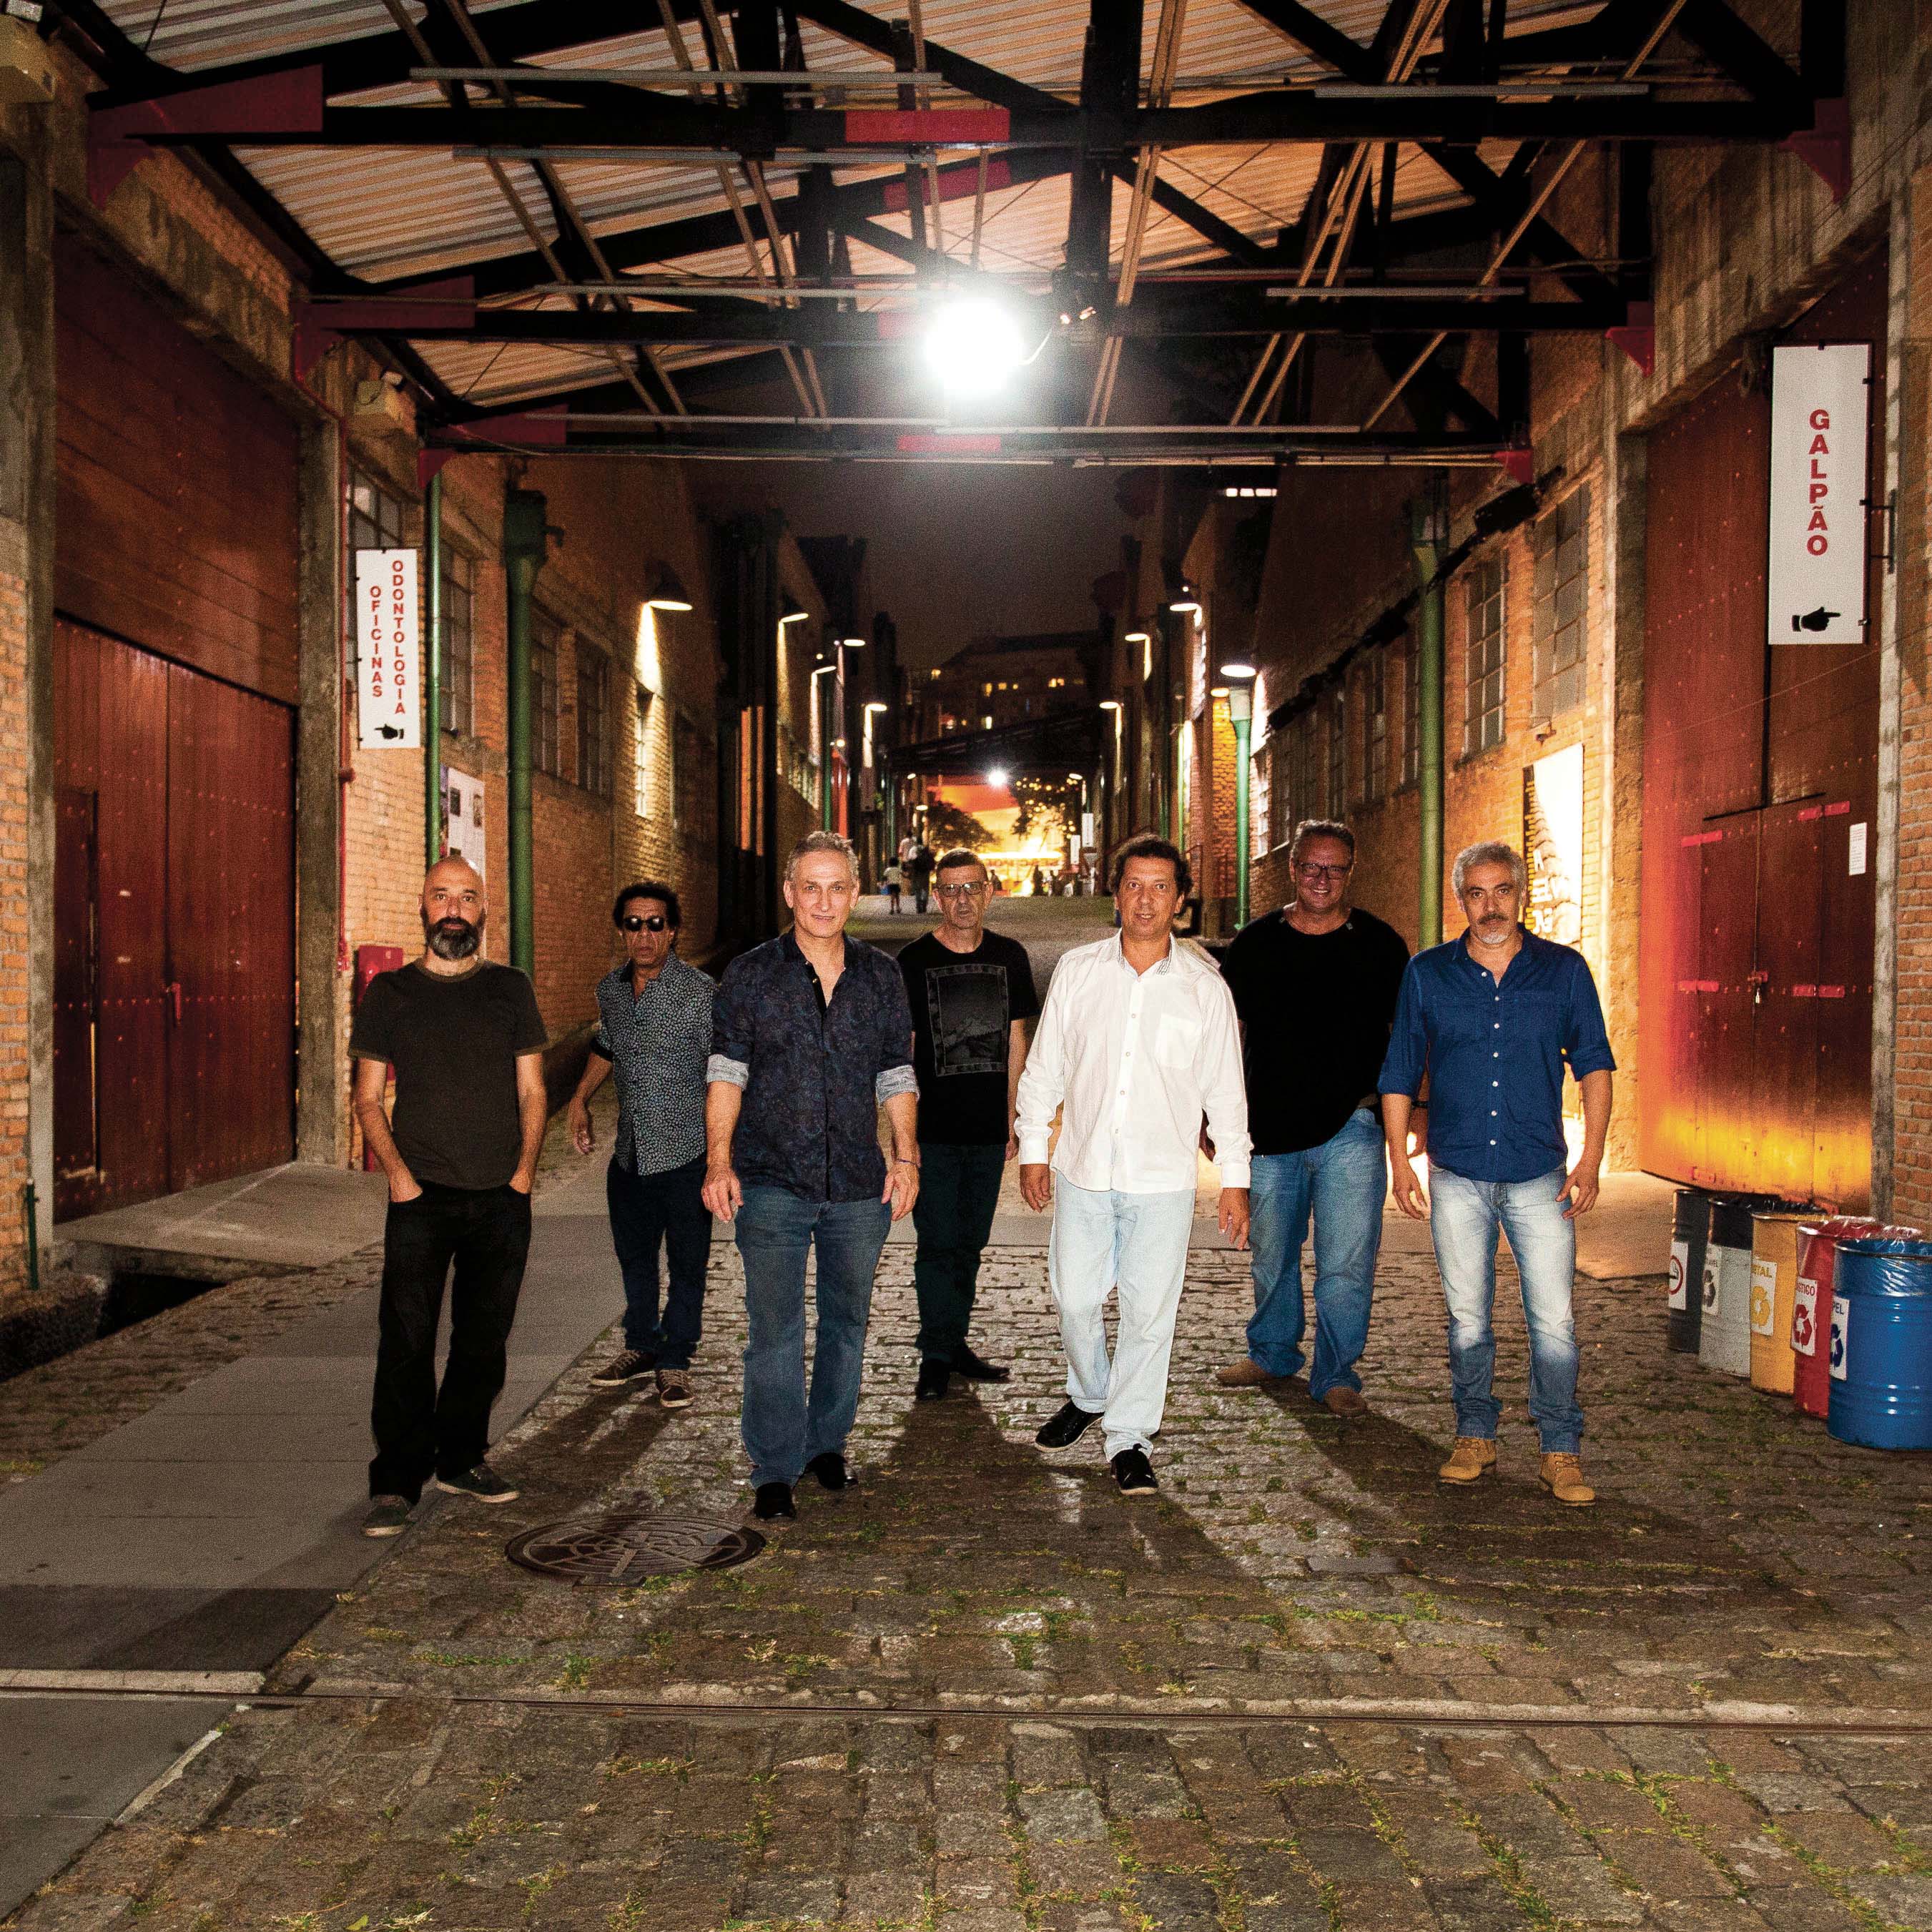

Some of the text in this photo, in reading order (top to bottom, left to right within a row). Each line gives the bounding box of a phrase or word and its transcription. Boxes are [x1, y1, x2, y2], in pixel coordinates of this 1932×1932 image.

[1807, 408, 1830, 556] GALPÃO
[370, 585, 383, 698] OFICINAS
[392, 560, 405, 714] ODONTOLOGIA
[1797, 1282, 1815, 1296] STICO
[1833, 1301, 1844, 1315] PEL
